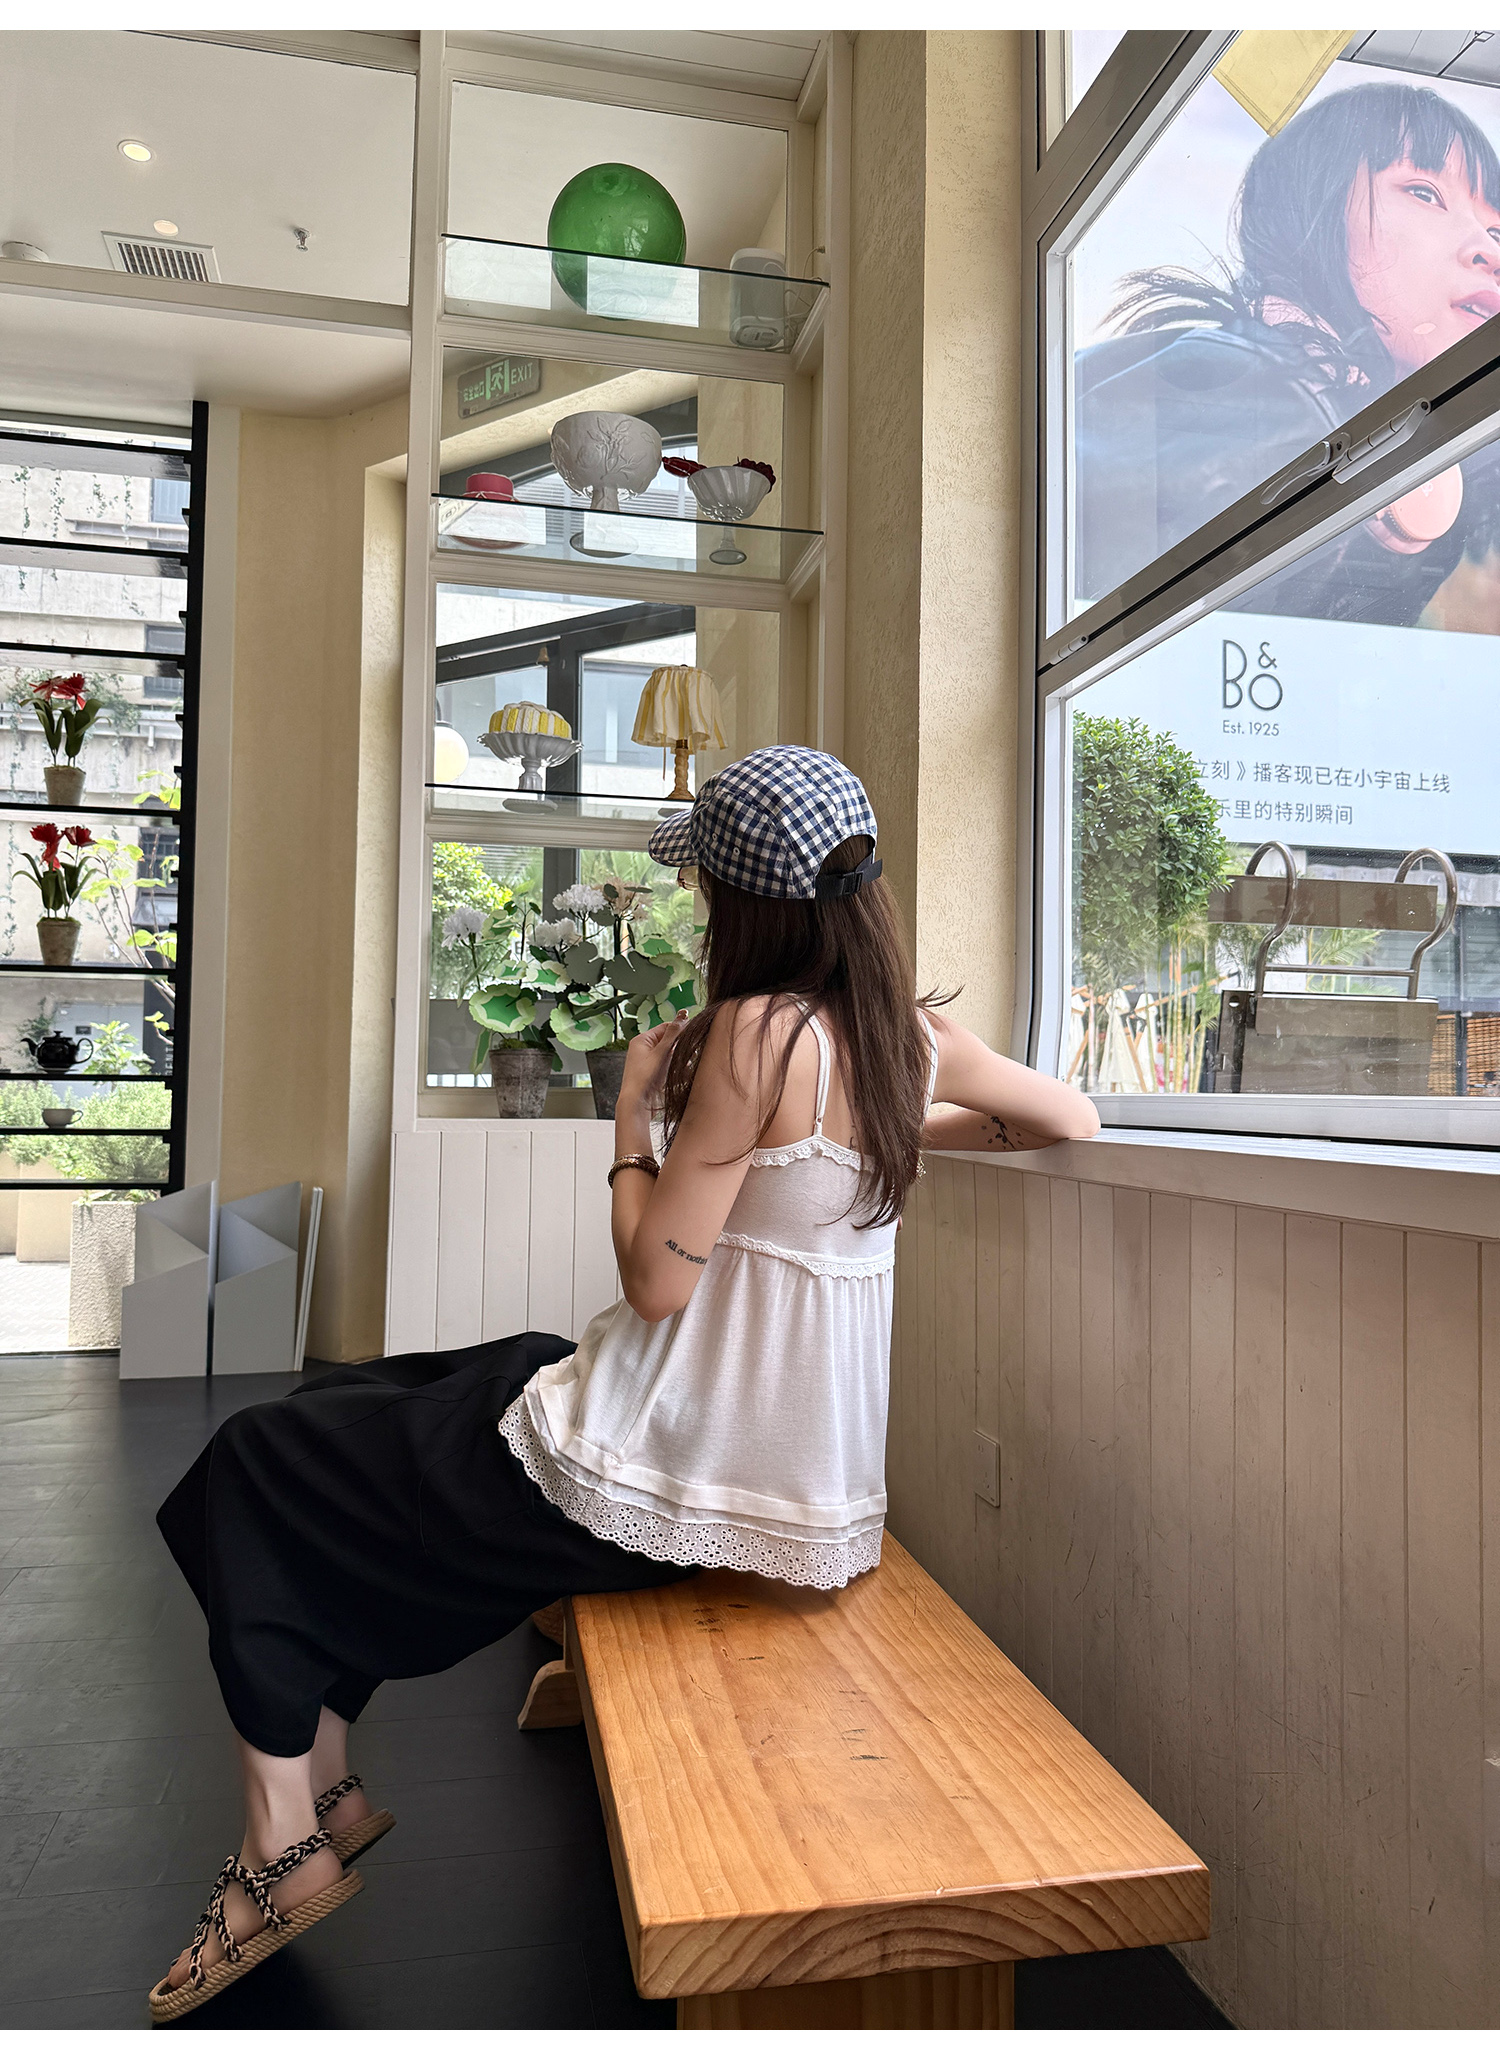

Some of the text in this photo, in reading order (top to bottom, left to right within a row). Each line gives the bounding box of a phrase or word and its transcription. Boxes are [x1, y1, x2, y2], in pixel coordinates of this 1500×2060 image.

[511, 362, 533, 385] EXIT
[1222, 719, 1280, 737] Est. 1925
[665, 1239, 679, 1252] All
[677, 1248, 687, 1257] or
